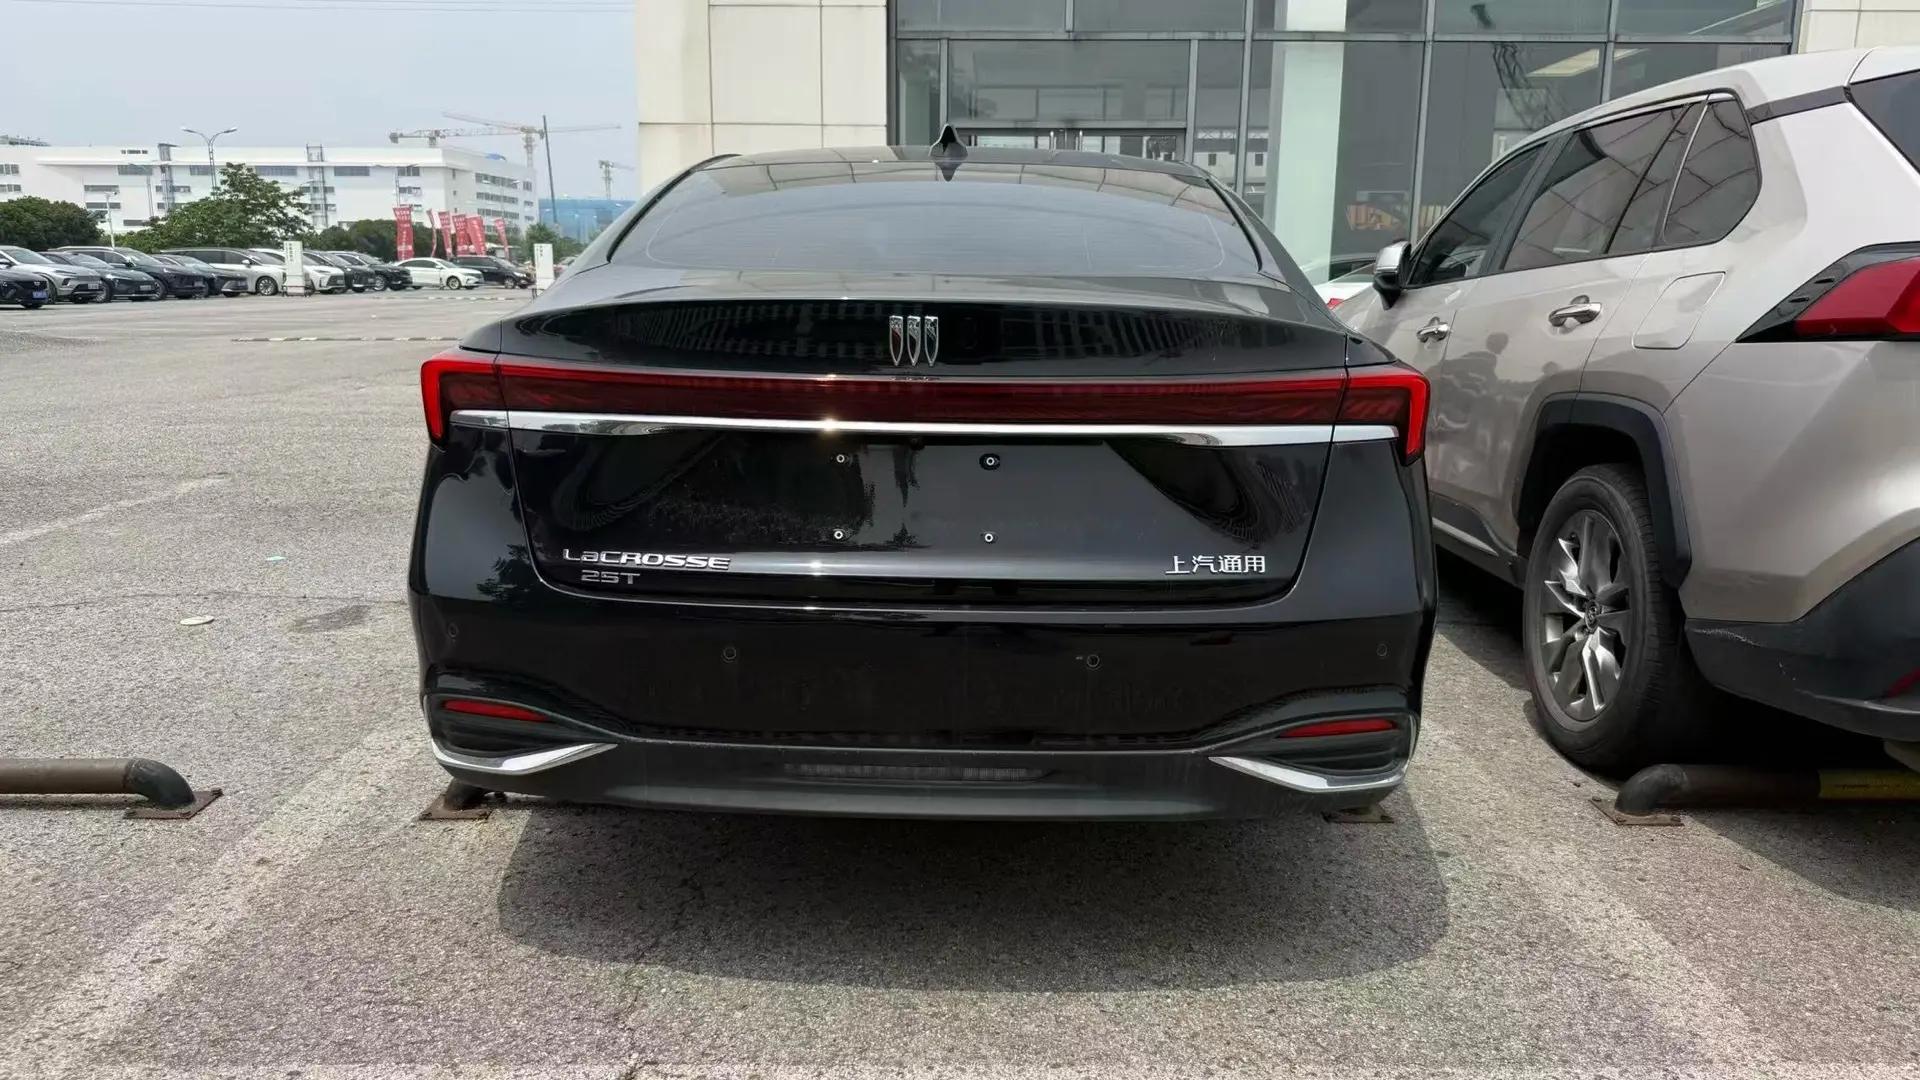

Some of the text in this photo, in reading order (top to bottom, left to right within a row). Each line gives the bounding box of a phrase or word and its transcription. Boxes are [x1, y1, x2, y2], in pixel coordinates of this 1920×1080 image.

[563, 548, 731, 571] LaCROSSE
[1165, 555, 1266, 574] 上汽通用
[580, 569, 640, 585] 25T
